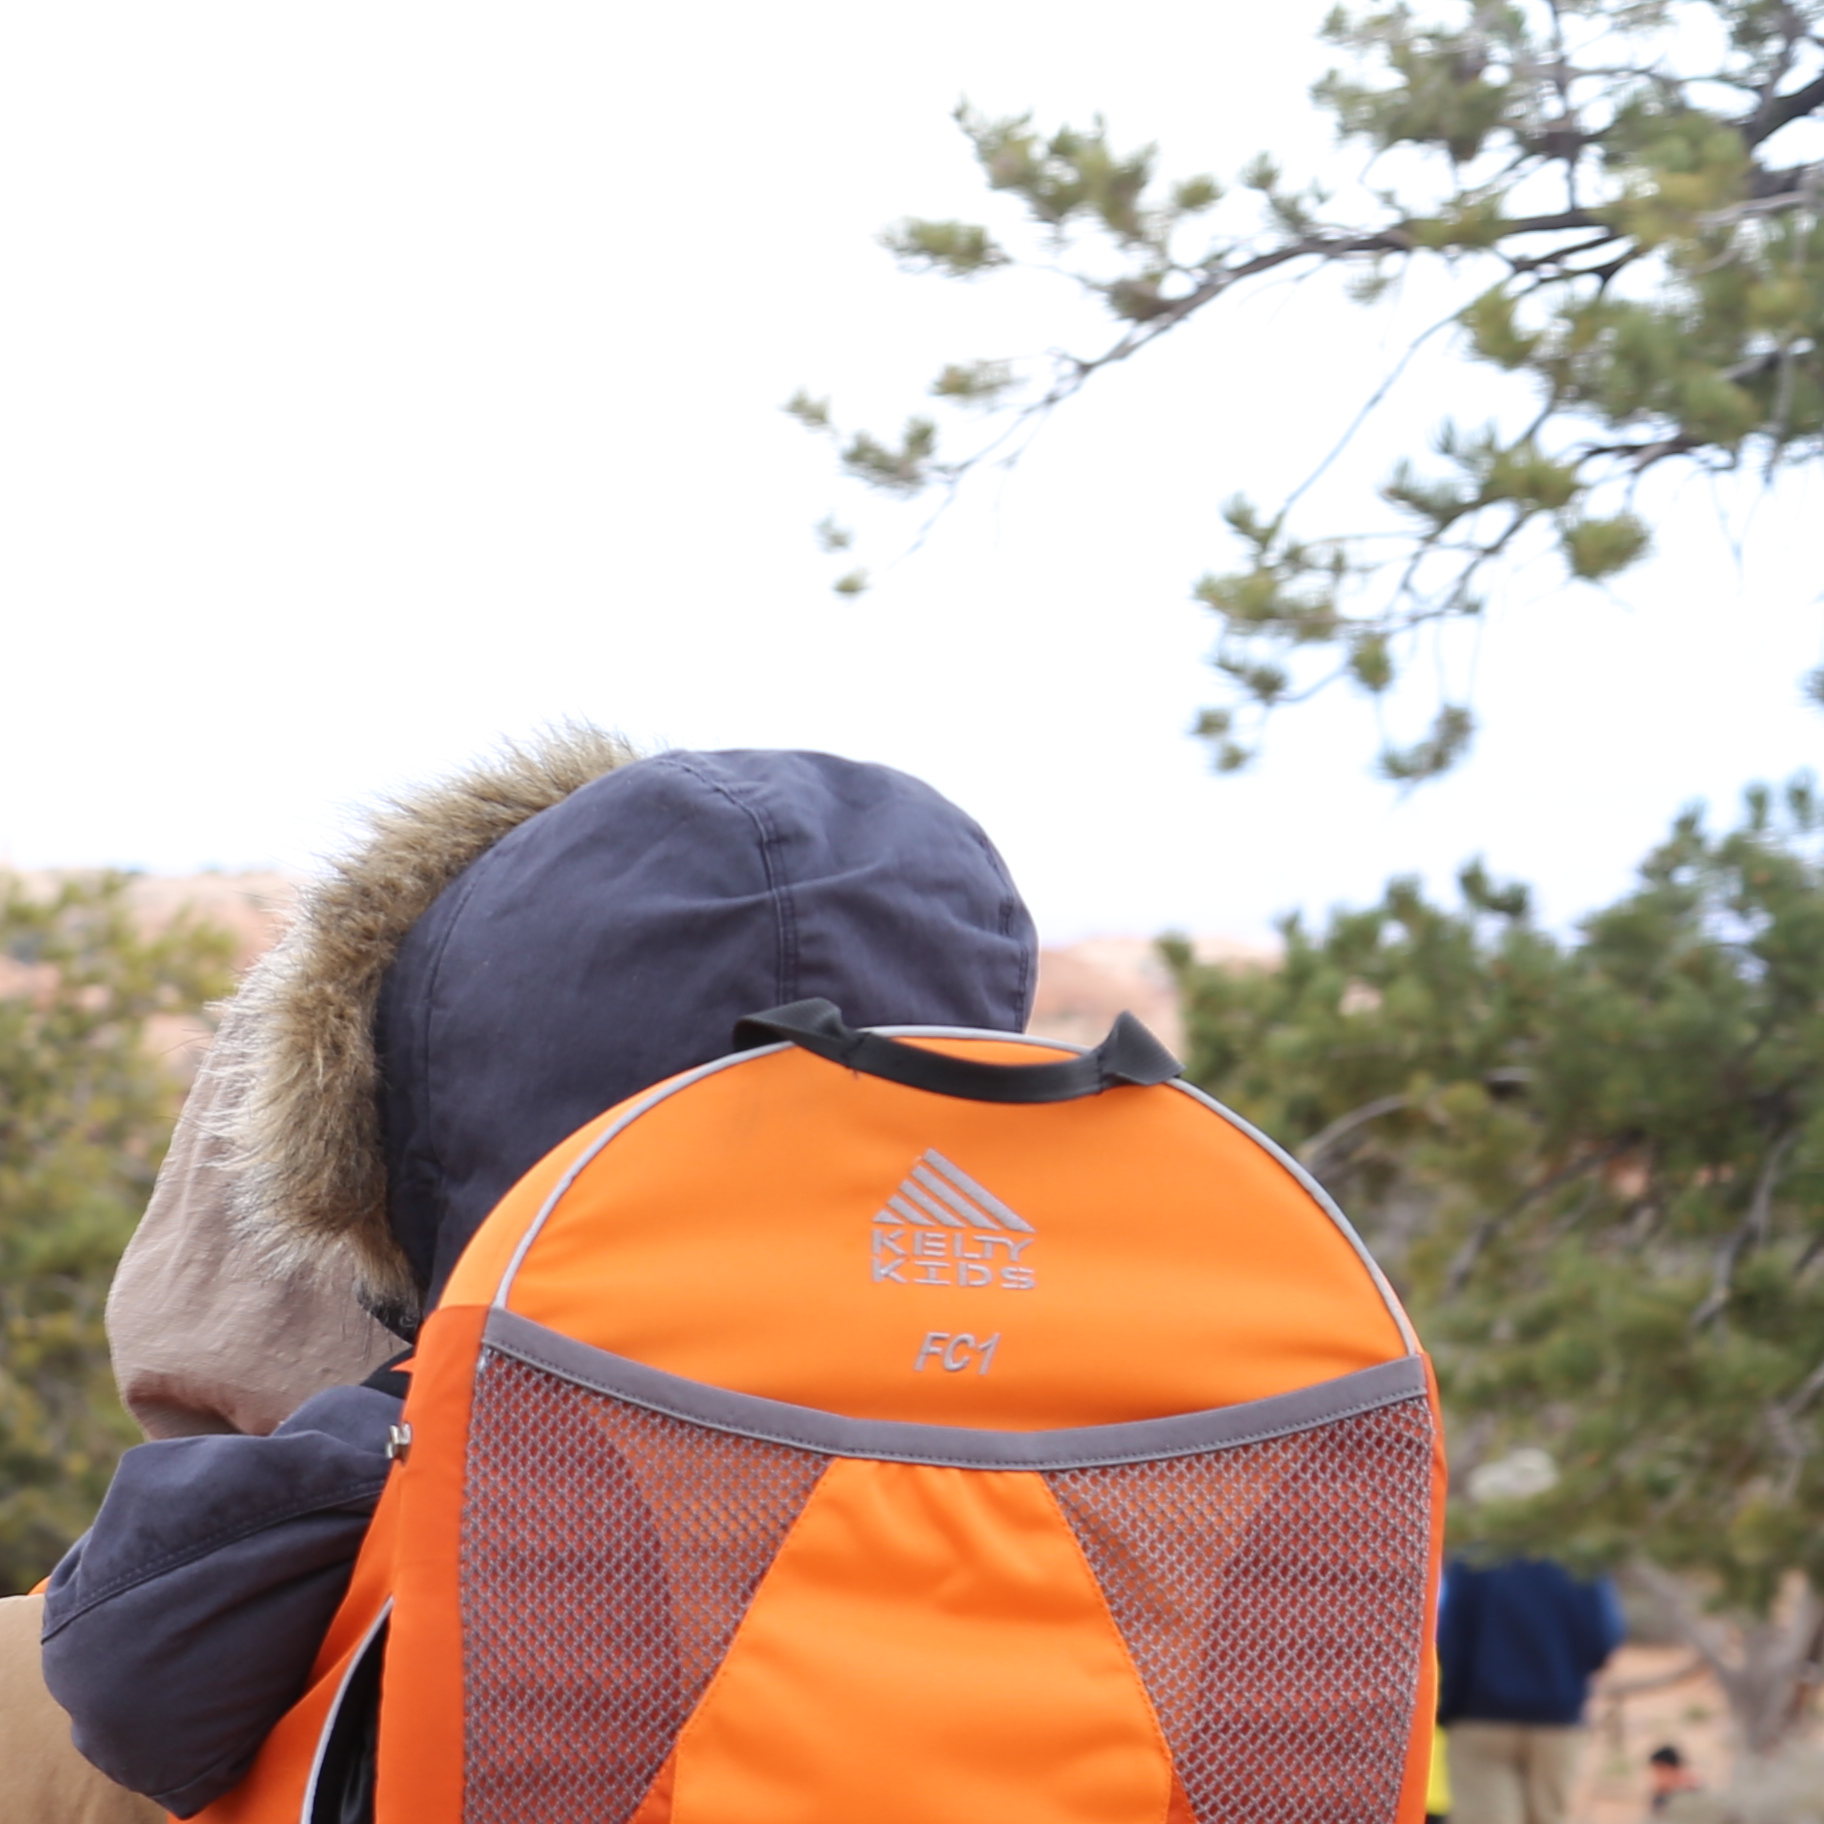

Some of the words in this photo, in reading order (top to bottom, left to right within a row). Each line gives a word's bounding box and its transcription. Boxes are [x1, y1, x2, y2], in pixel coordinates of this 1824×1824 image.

[871, 1228, 1036, 1262] KELTY
[871, 1256, 1038, 1290] KIDS
[913, 1331, 1002, 1376] FC1
